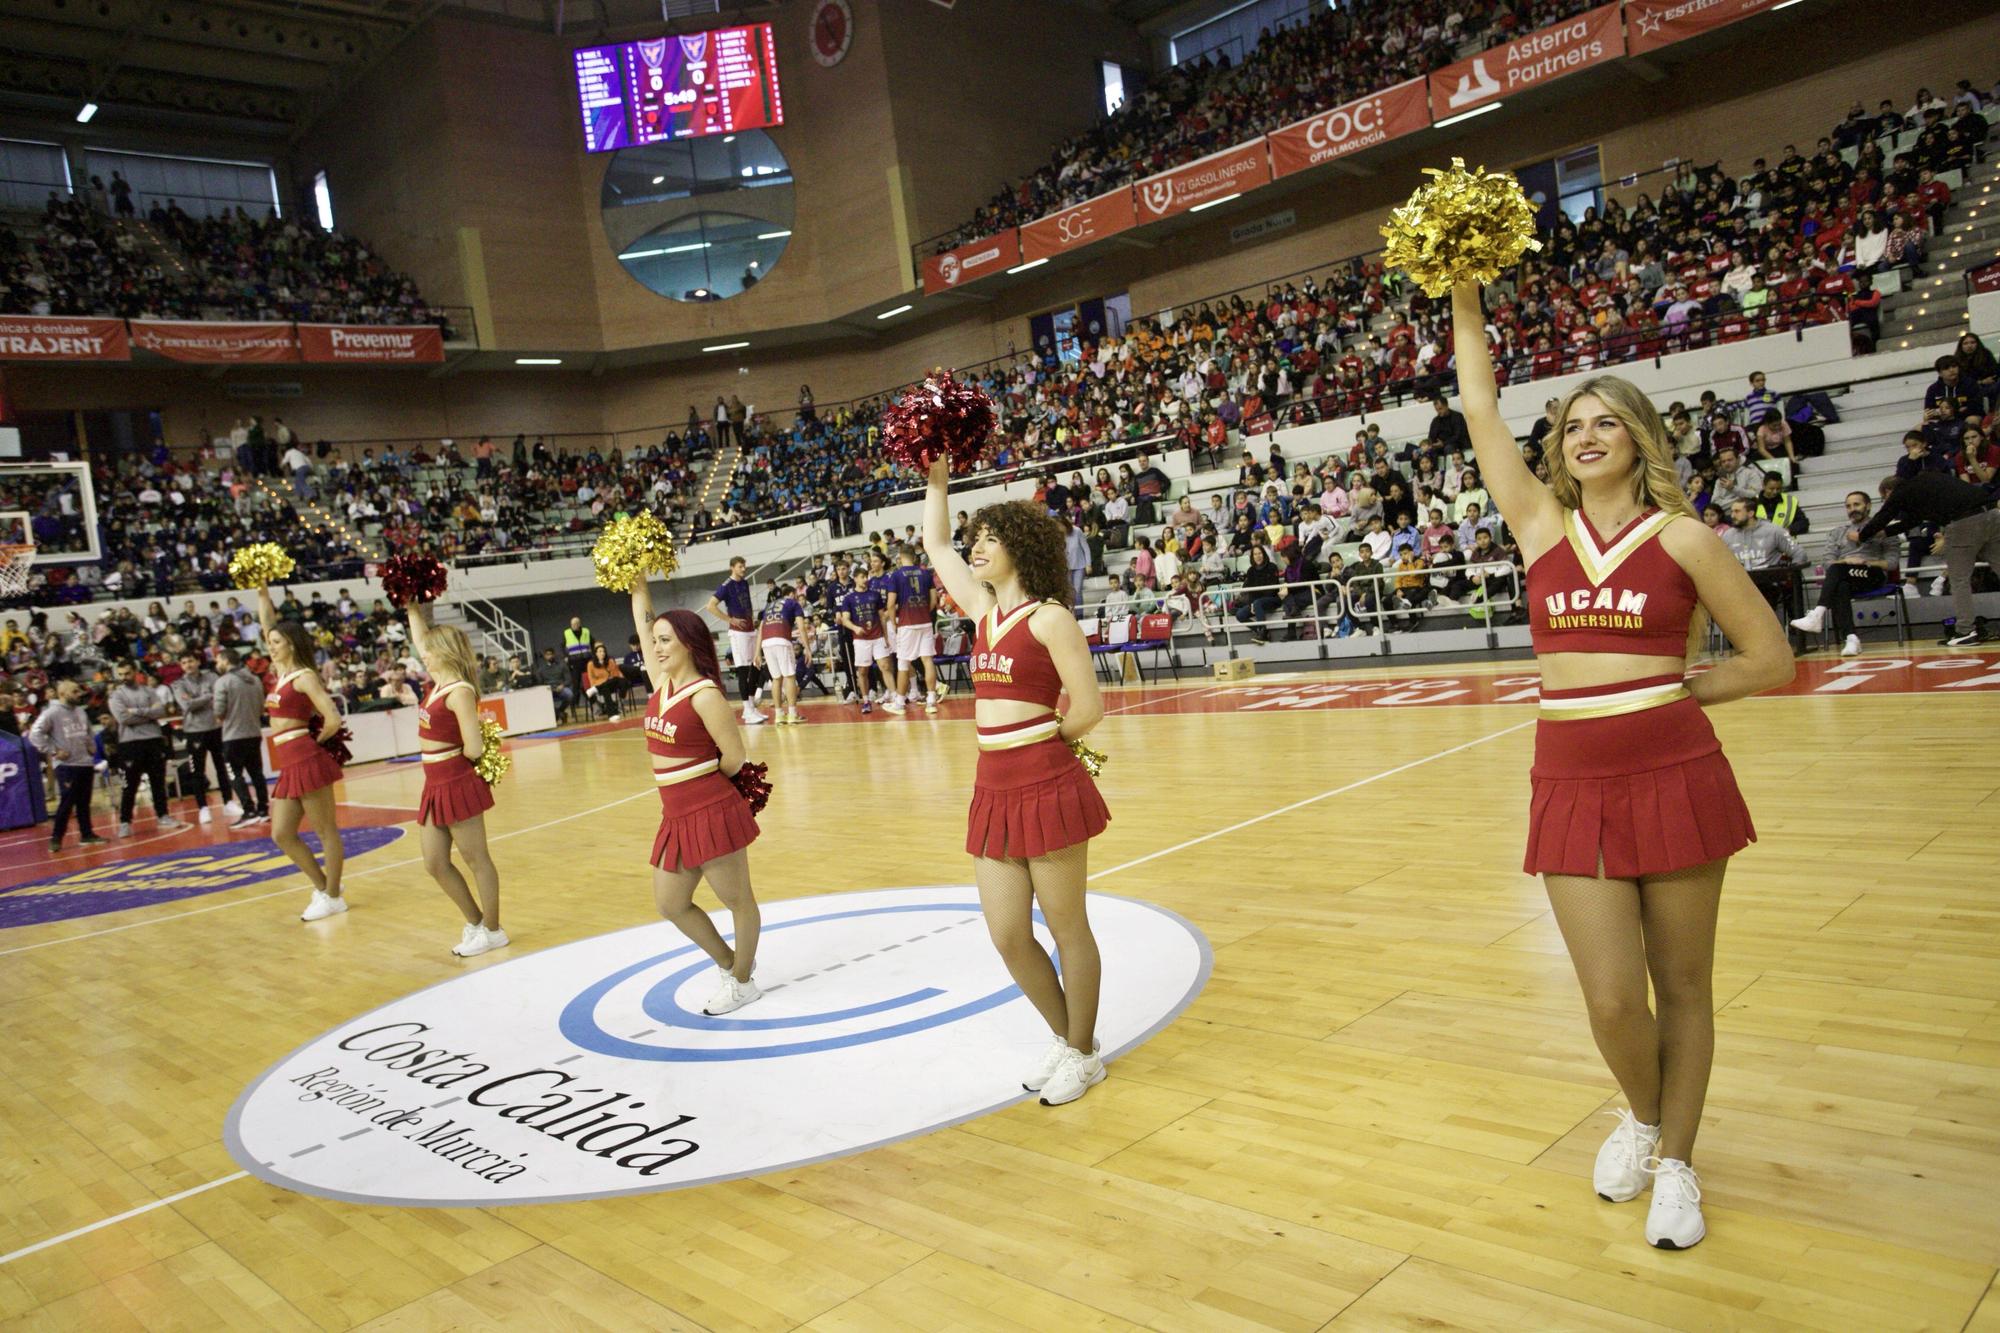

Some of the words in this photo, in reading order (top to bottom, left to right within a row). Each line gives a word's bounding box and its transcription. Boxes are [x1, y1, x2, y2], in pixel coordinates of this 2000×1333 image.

[1507, 21, 1587, 64] Asterra
[1508, 40, 1603, 88] Partners
[1310, 130, 1386, 163] OFTALMOLOGÍA
[1188, 157, 1257, 190] GASOLINERAS
[32, 324, 90, 335] dentales
[330, 329, 414, 348] Prevemur
[1545, 587, 1648, 615] UCAM
[1549, 614, 1643, 629] UNIVERSIDAD
[970, 652, 1014, 675] UCAM
[644, 716, 677, 737] UCAM
[338, 1022, 490, 1090] Costa
[467, 1070, 700, 1176] Cálida
[289, 1066, 387, 1114] Región
[370, 1106, 426, 1132] de
[402, 1119, 529, 1184] Murcia
